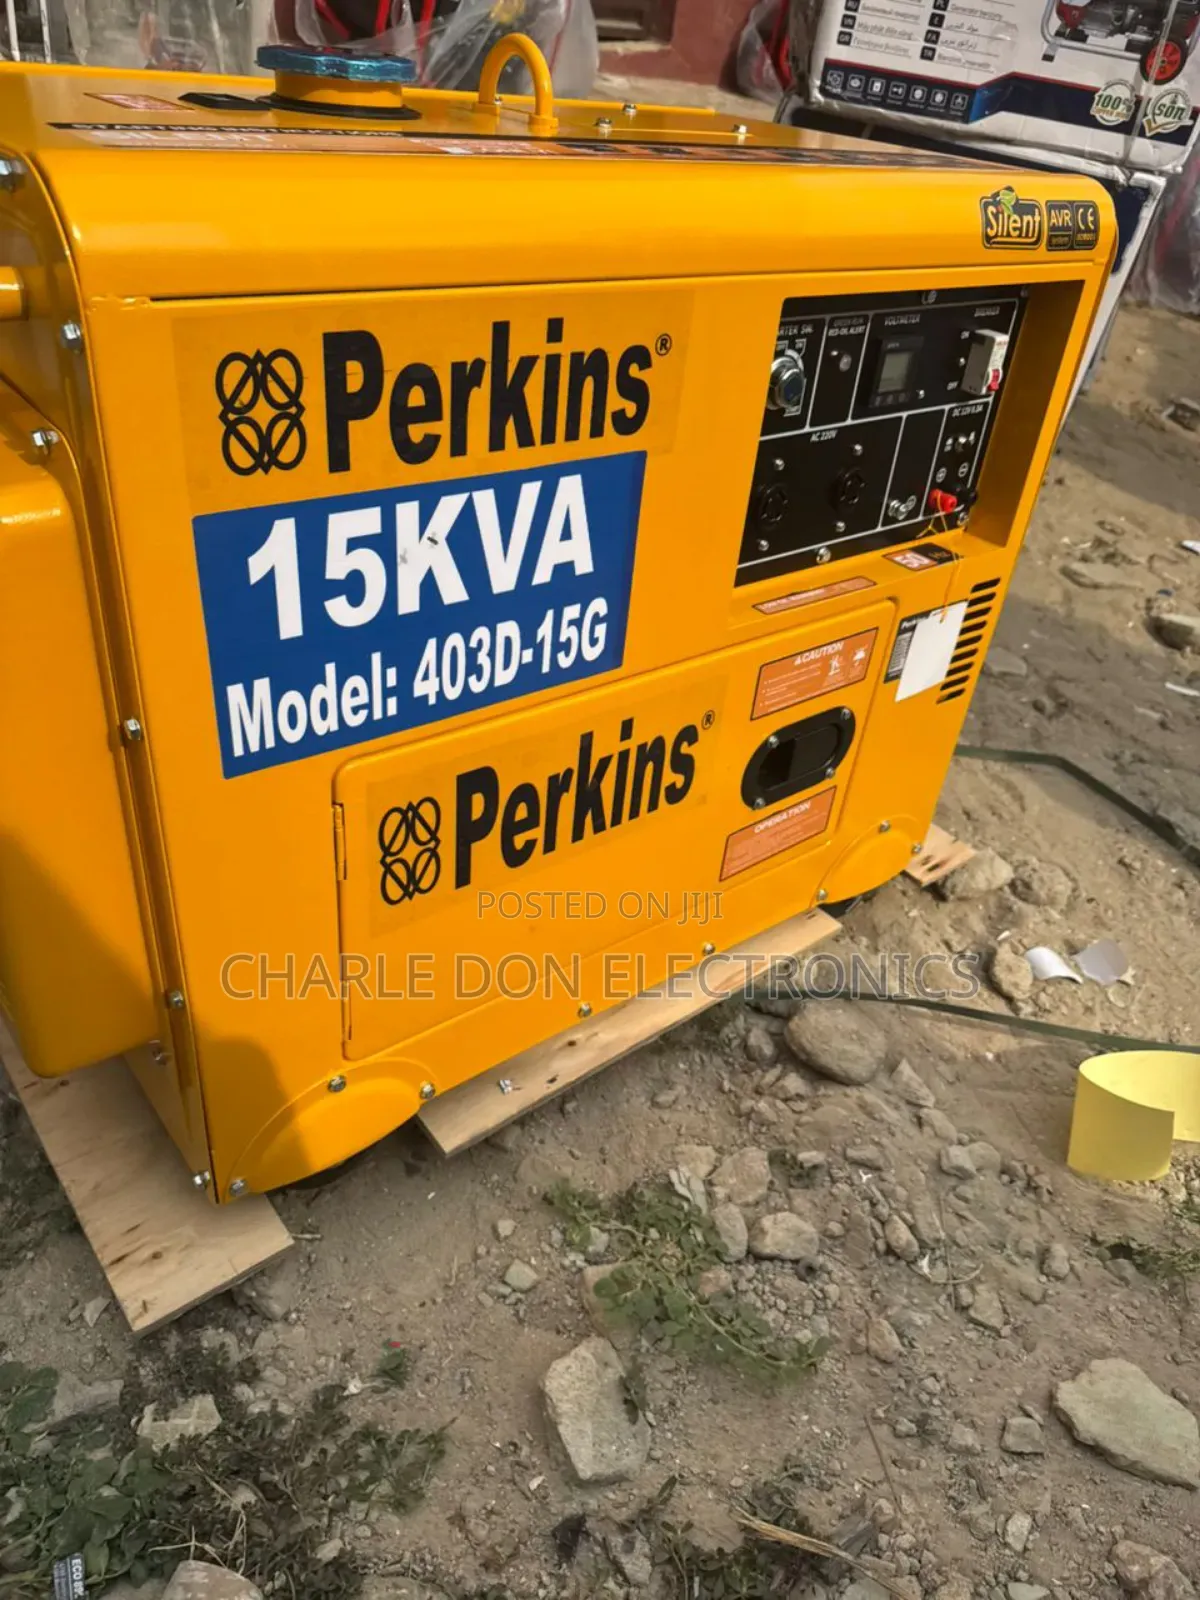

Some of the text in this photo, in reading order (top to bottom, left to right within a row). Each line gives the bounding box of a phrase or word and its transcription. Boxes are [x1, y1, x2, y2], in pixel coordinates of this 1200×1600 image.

[986, 204, 1041, 238] Silent
[1049, 209, 1073, 227] AVR
[321, 316, 654, 474] Perkins
[247, 474, 595, 640] 15KVA
[225, 596, 609, 757] Model: 403D-15G
[454, 716, 700, 890] Perkins
[72, 1559, 82, 1580] ECO
